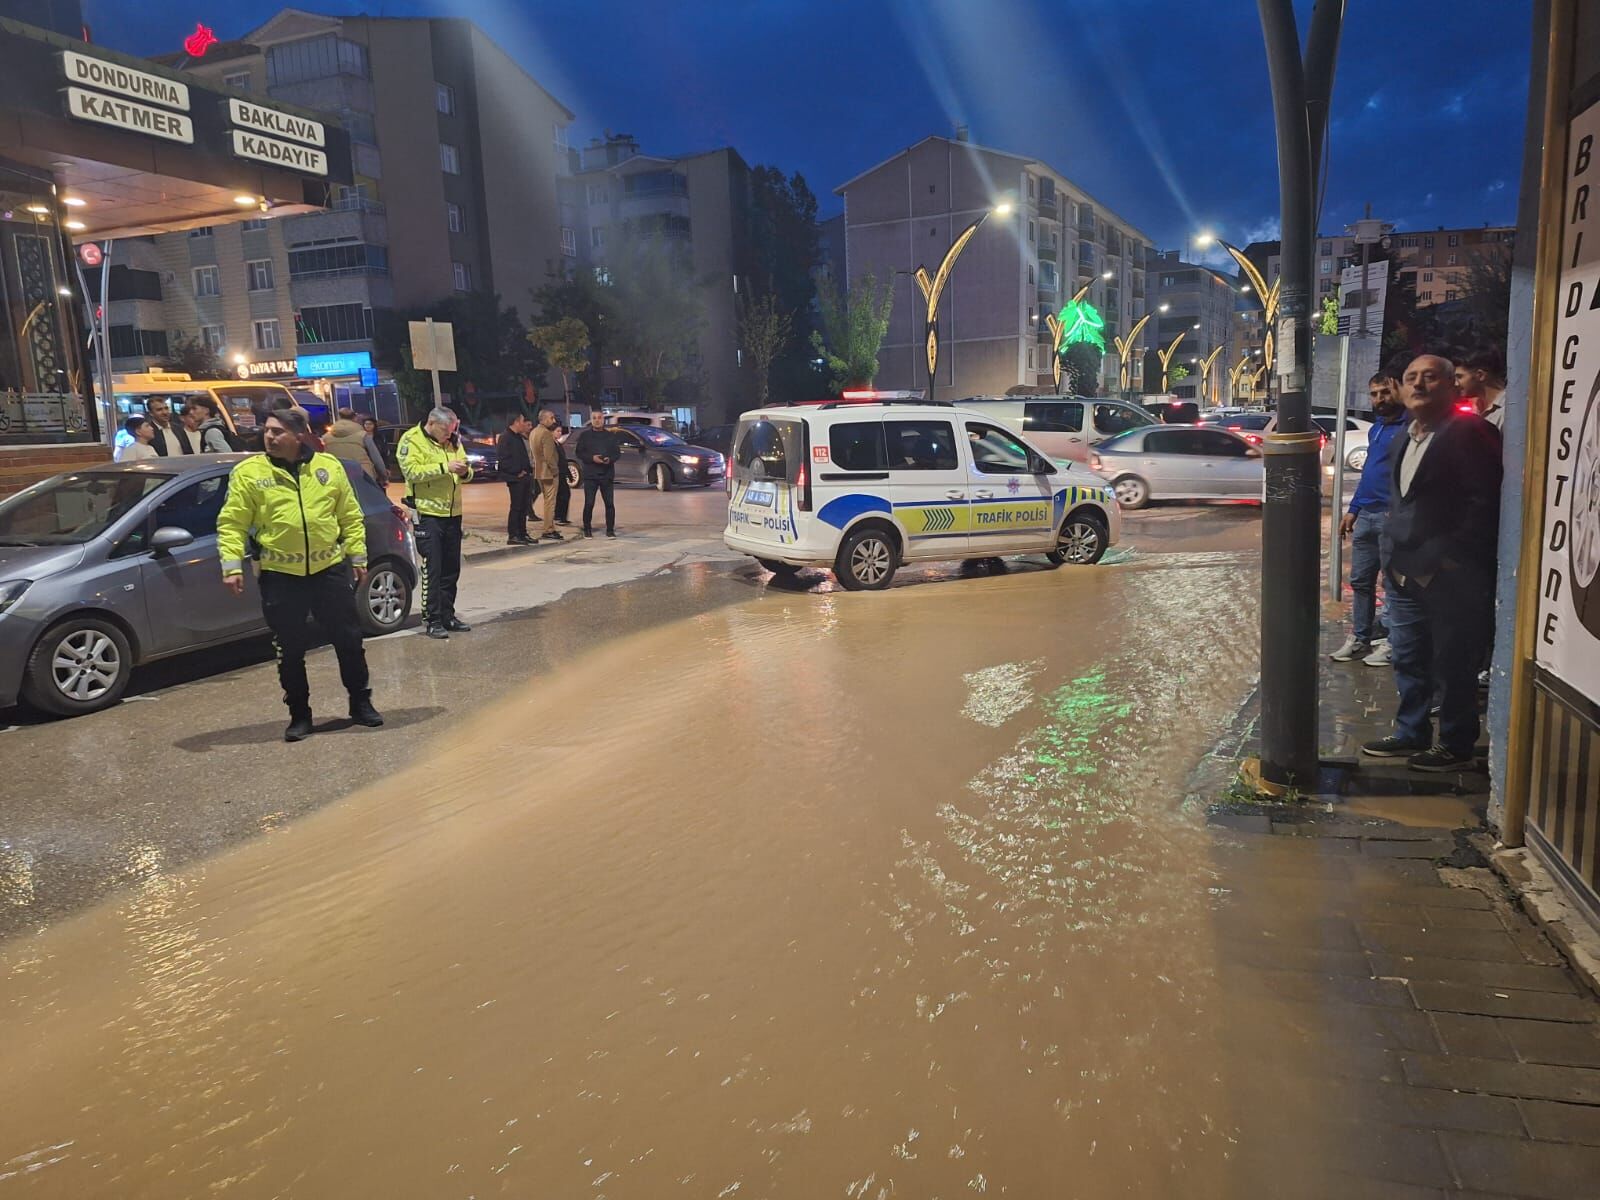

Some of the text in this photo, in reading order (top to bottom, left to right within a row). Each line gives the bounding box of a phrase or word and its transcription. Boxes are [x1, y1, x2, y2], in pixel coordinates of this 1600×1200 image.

[76, 58, 180, 105] DONDURMA
[80, 94, 183, 137] KATMER
[238, 105, 317, 141] BAKLAVA
[242, 135, 319, 169] KADAYIF
[310, 359, 346, 372] ekomini
[1543, 134, 1593, 645] BRIDGESTONE
[815, 447, 827, 457] 112
[763, 515, 790, 532] POLİSİ
[976, 507, 1048, 524] TRAFİK POLİSİ
